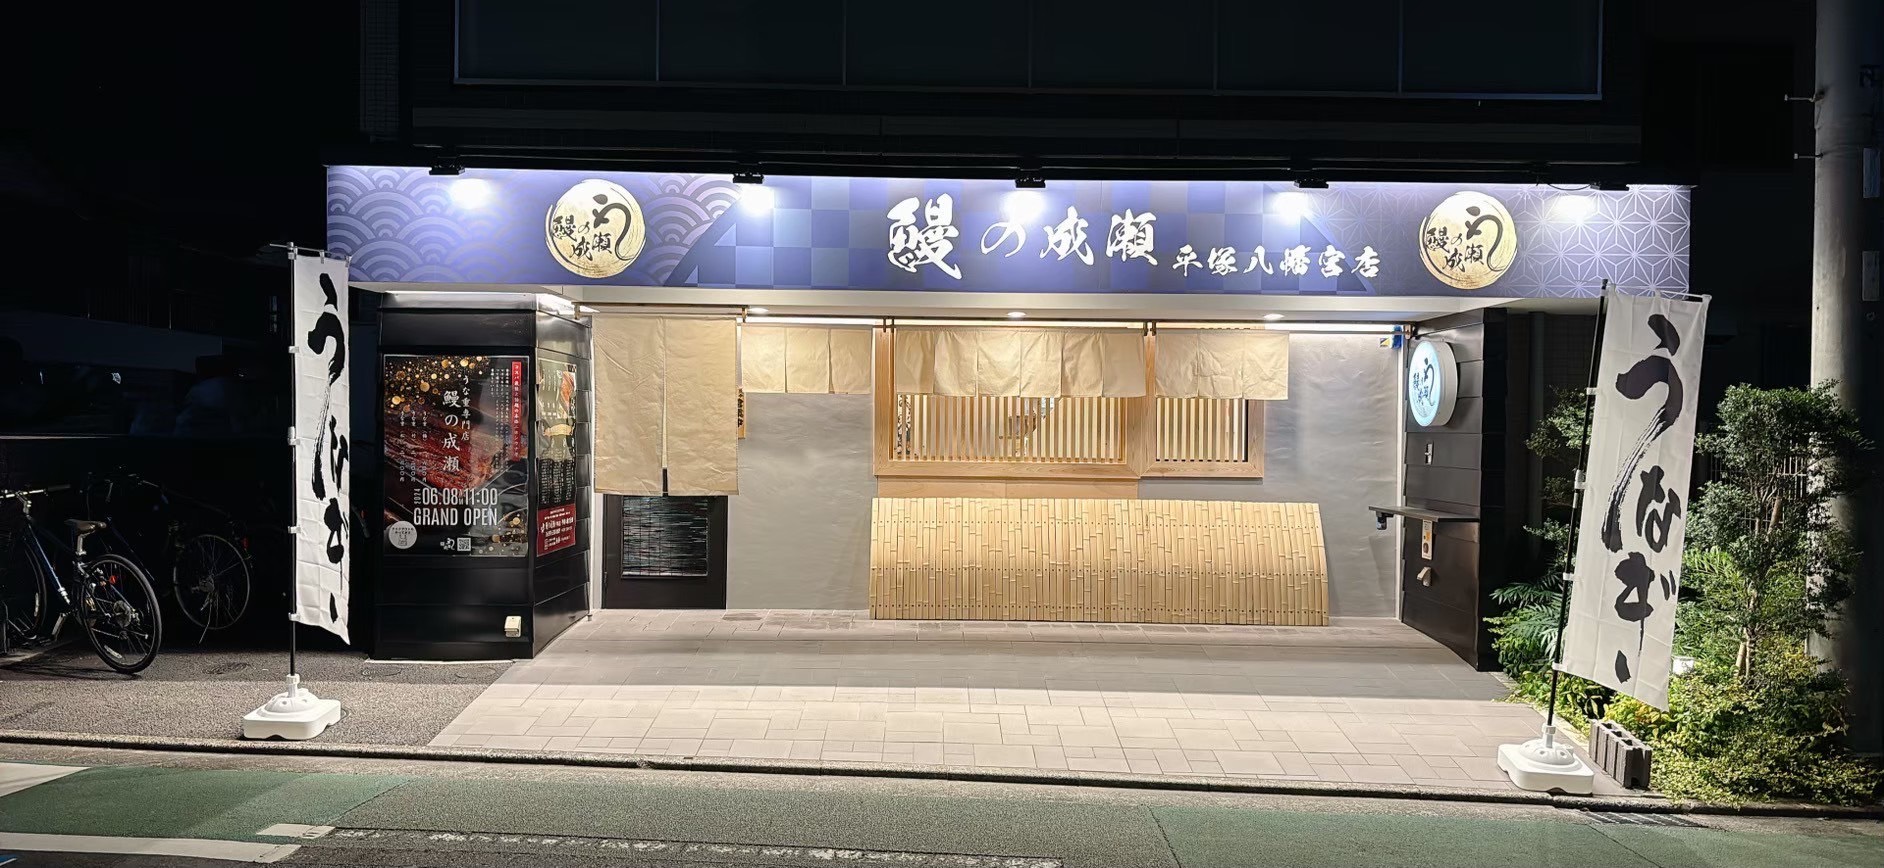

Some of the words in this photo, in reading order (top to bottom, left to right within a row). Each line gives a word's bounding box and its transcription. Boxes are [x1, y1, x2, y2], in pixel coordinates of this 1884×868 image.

[553, 215, 612, 261] 鰻の成瀬
[887, 193, 1158, 279] 鰻の成瀬
[1172, 244, 1381, 278] 平塚八幡宮店
[1426, 226, 1484, 272] 鰻の成瀬
[442, 390, 461, 472] 鰻の成瀬
[461, 375, 471, 441] うな重専門店
[307, 273, 348, 622] うなぎ
[414, 508, 458, 526] GRAND
[463, 508, 497, 526] OPEN
[464, 488, 498, 505] 11:00
[1601, 313, 1684, 684] うなぎ
